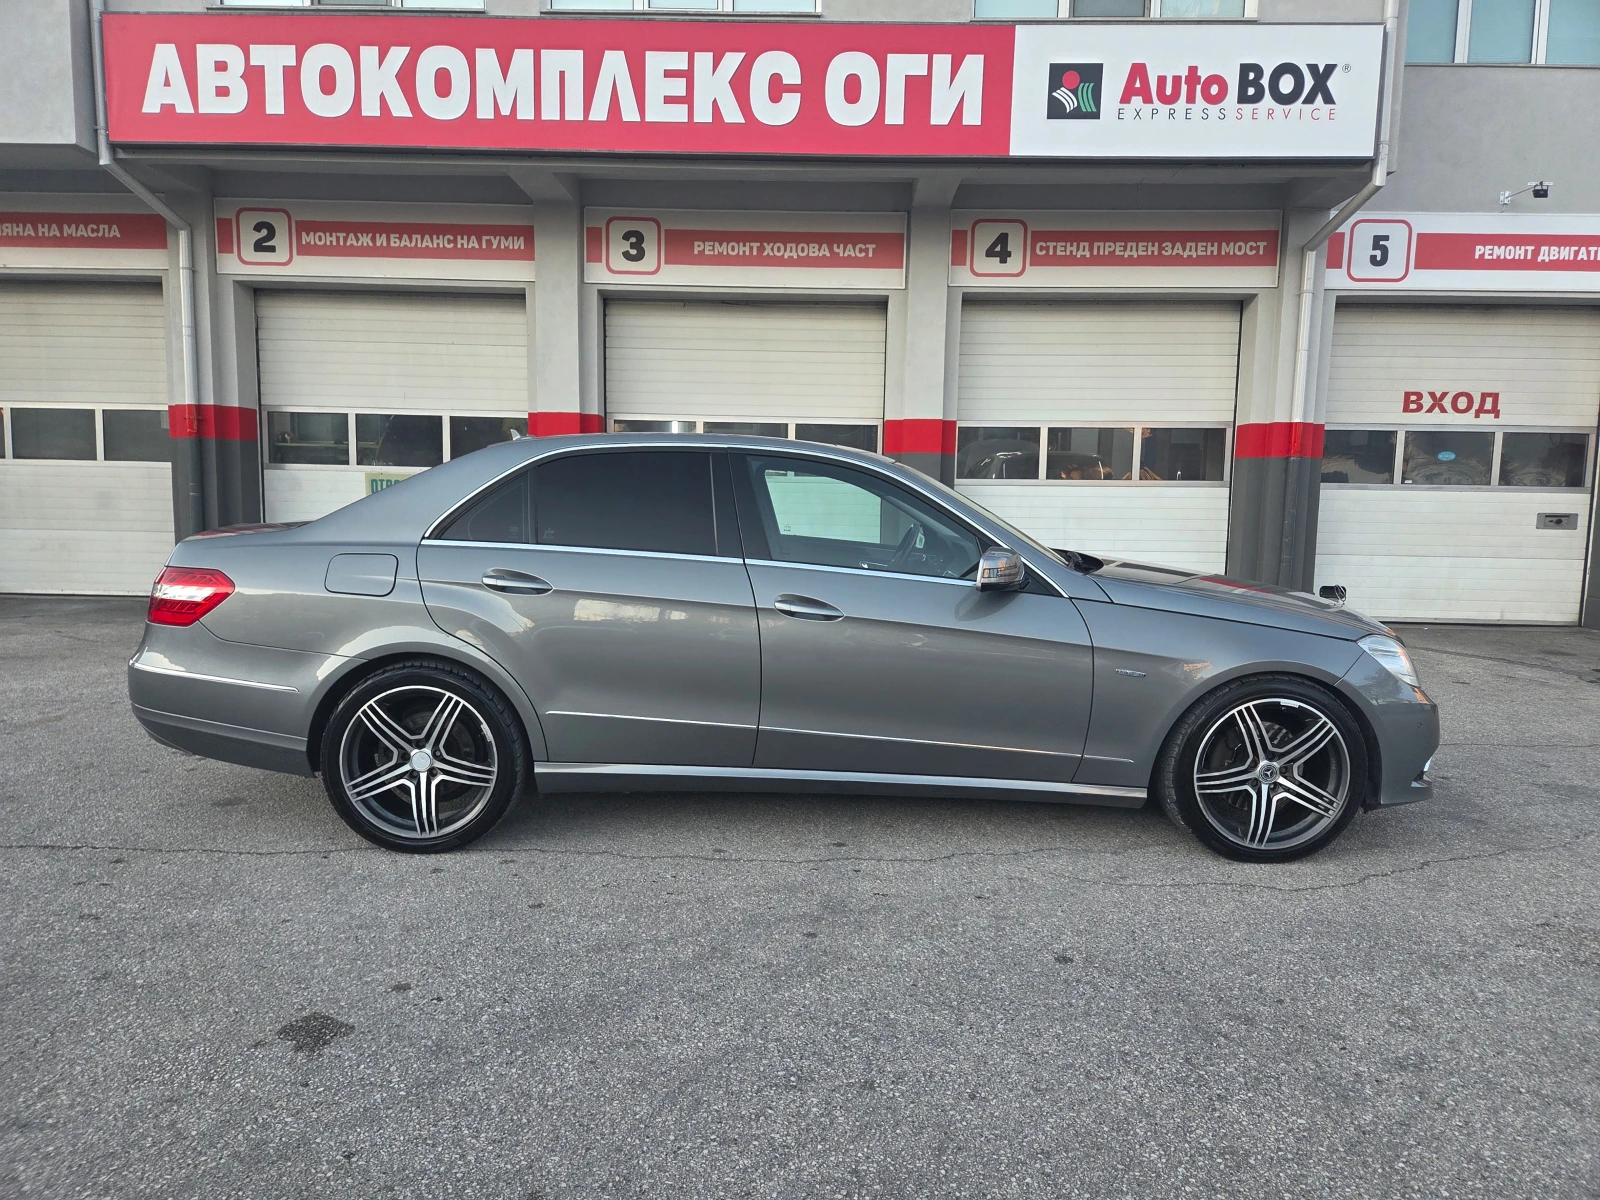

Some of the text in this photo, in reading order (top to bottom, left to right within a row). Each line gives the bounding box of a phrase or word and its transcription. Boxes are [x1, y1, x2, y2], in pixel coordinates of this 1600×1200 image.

[142, 43, 985, 127] АВТОКОМПЛЕКС ОГИ
[0, 223, 121, 238] ЯНА НА МАСЛА
[253, 221, 276, 252] 2
[301, 231, 525, 250] МОНТАЖ И БАЛАНС НА ГУМИ
[621, 229, 646, 263] 3
[693, 241, 876, 259] РЕМОНТ ХОДОВА ЧАСТ
[985, 231, 1012, 264] 4
[1035, 241, 1267, 258] СТЕНД ПРЕДЕН ЗАДЕН МОСТ
[1370, 234, 1390, 267] 5
[1475, 245, 1535, 260] РЕМОНТ
[1402, 391, 1500, 419] ВХОД
